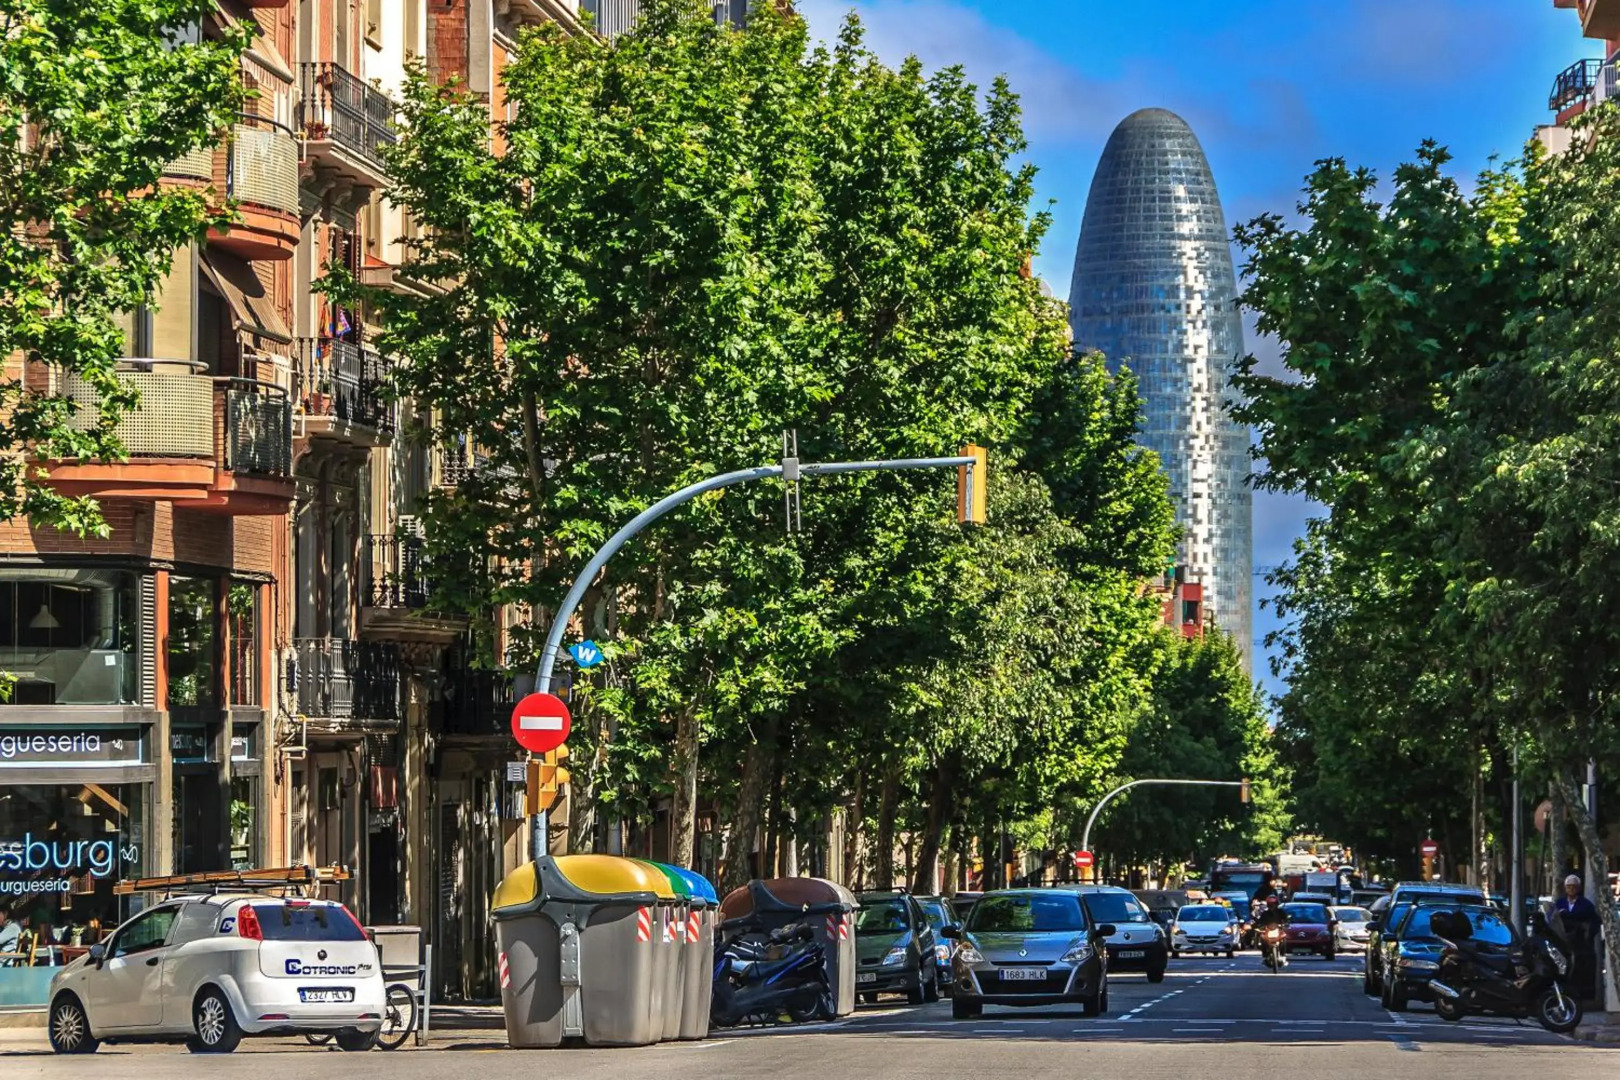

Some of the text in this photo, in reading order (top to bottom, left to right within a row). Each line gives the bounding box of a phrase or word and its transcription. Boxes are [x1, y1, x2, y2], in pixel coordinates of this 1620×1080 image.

[578, 645, 597, 662] W
[0, 732, 101, 758] gueseria
[285, 959, 356, 975] COTRONIC
[1005, 970, 1046, 979] 1683 HLK
